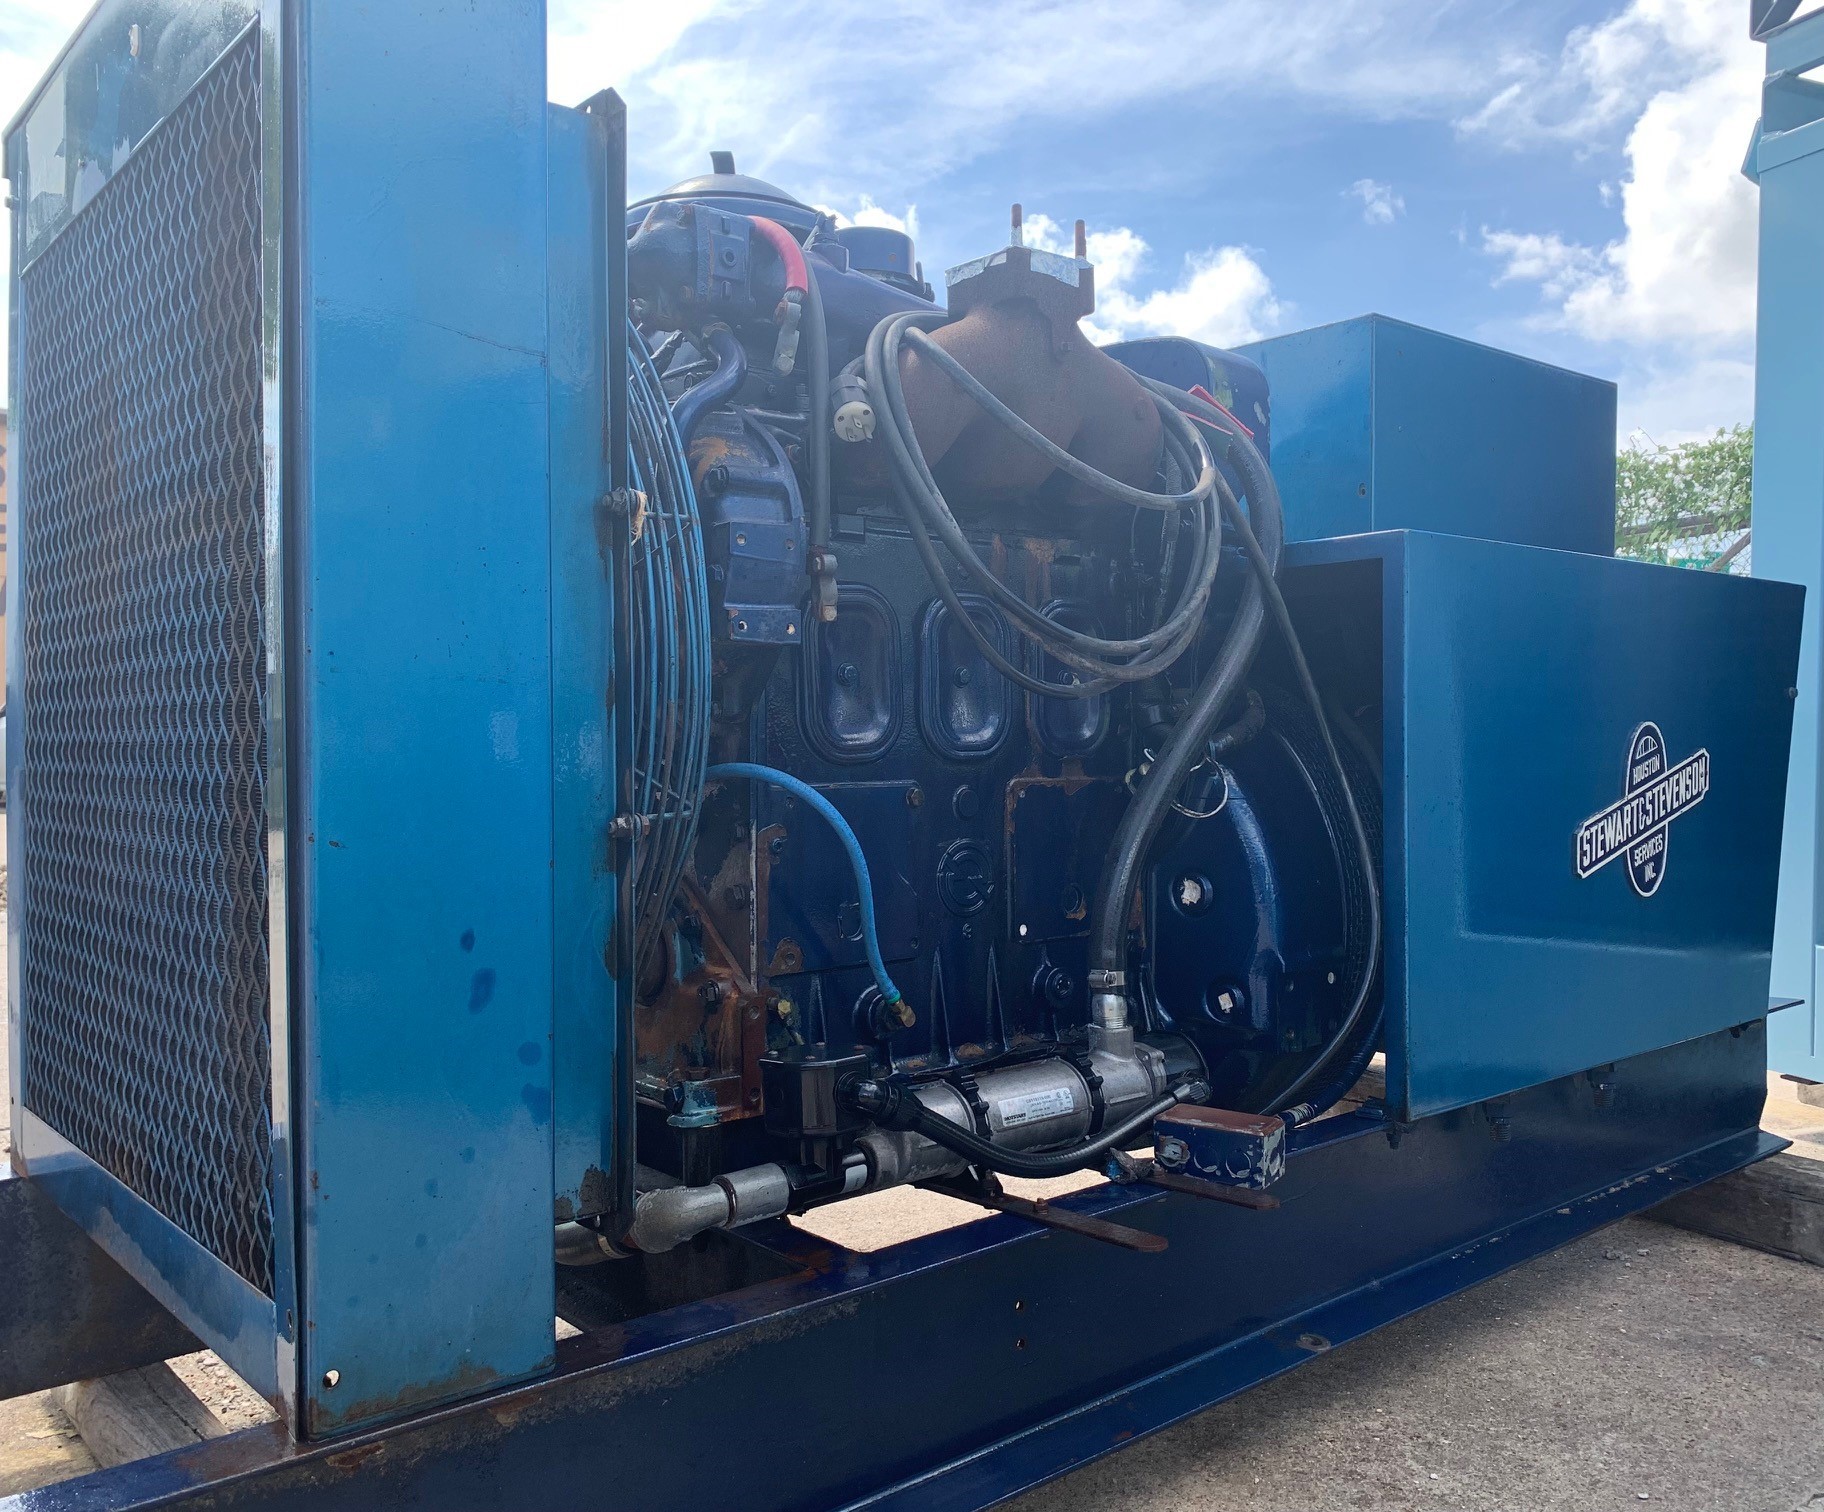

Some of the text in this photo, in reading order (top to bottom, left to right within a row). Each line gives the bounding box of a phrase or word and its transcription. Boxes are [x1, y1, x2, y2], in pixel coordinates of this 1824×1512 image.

[1633, 754, 1660, 785] HOUSTON
[1634, 833, 1663, 867] SERVICES
[1004, 1112, 1027, 1121] HOTSTART
